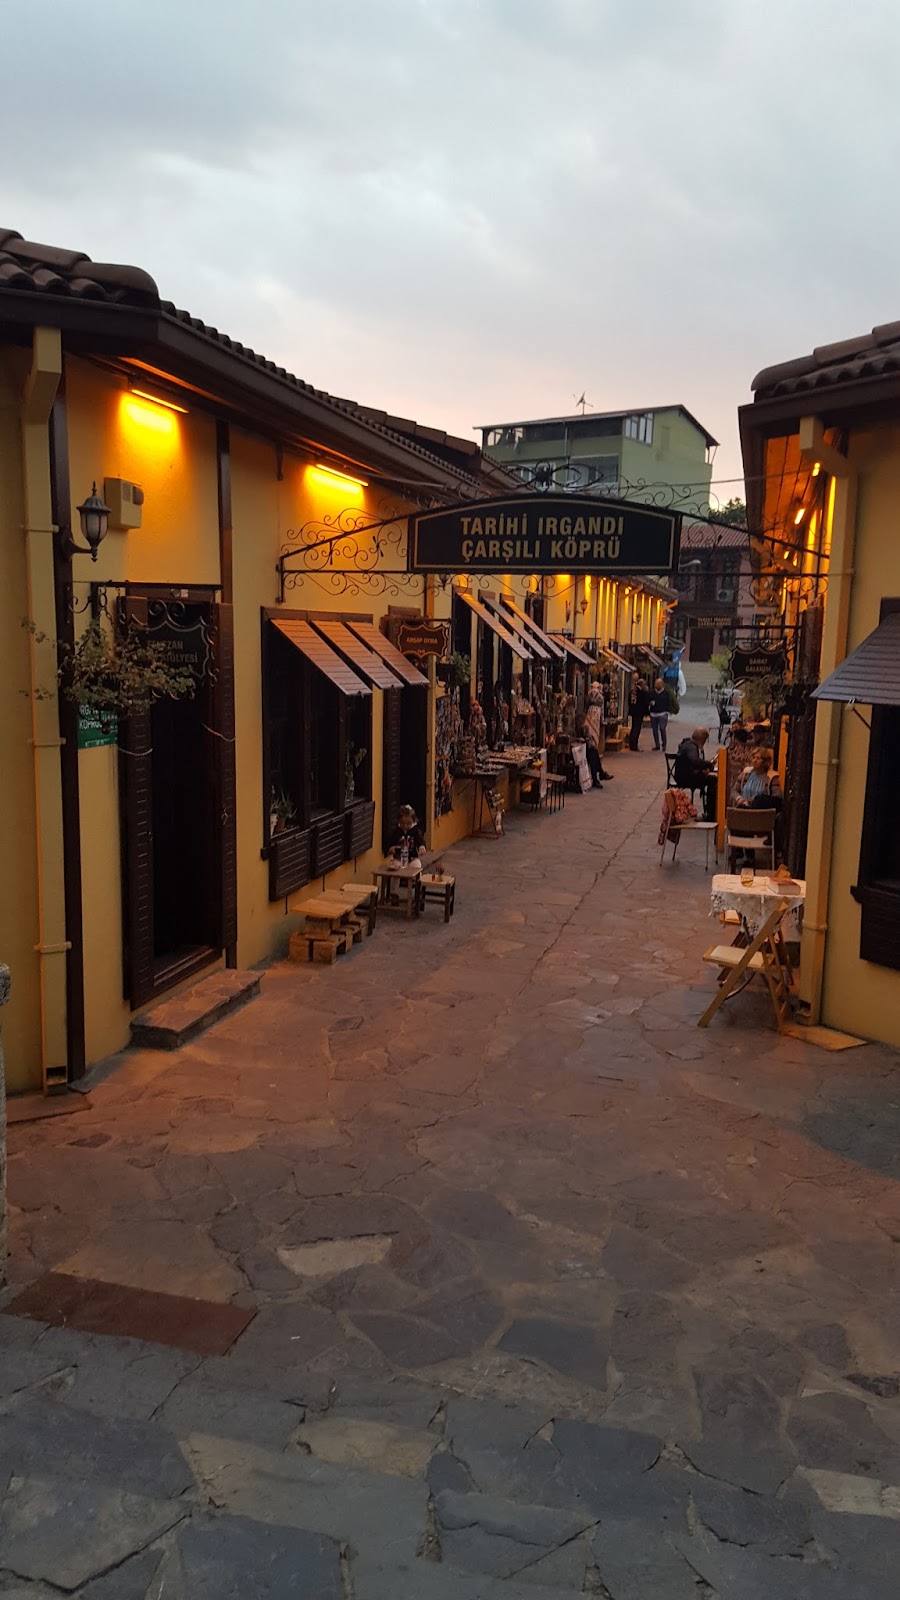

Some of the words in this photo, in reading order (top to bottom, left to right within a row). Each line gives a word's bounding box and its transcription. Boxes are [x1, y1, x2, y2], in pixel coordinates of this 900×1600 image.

[460, 513, 528, 535] TARİHİ
[537, 516, 625, 536] IRGANDI
[461, 539, 541, 563] ÇARŞILI
[551, 537, 621, 559] KÖPRÜ
